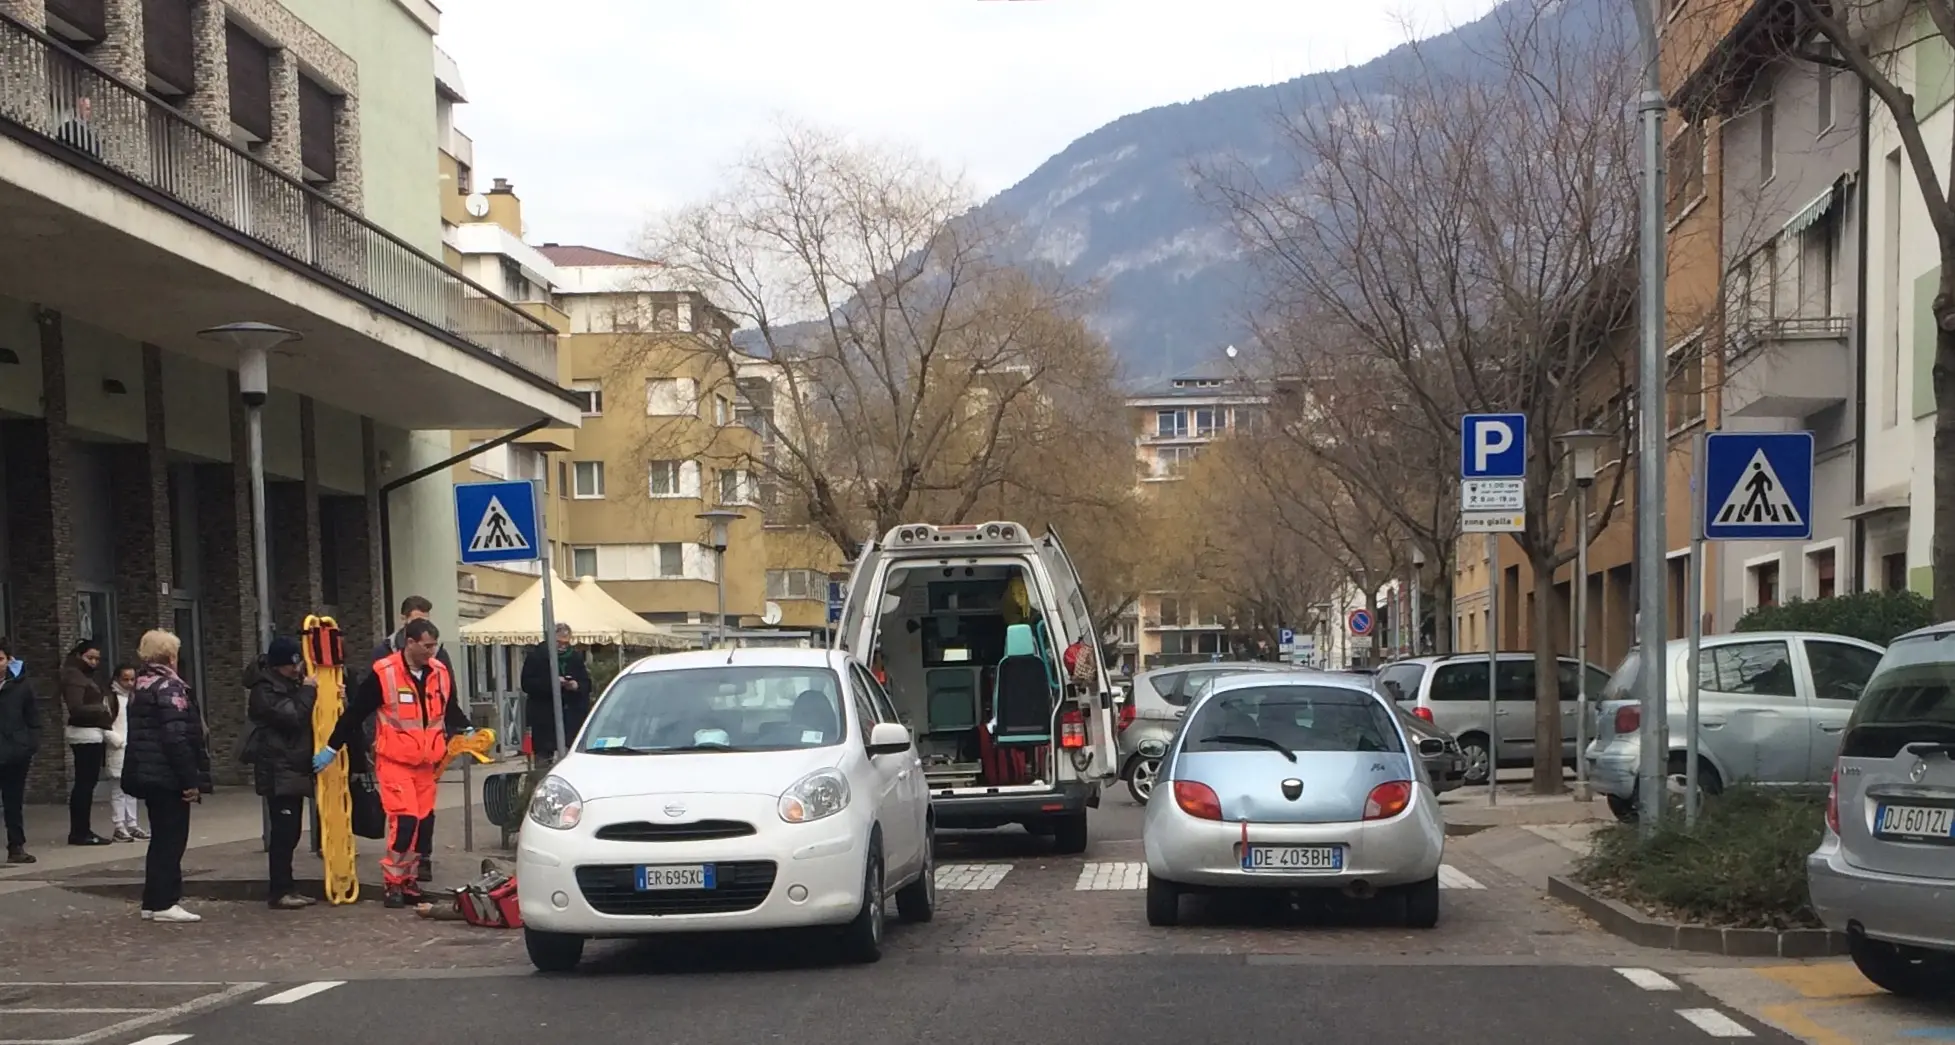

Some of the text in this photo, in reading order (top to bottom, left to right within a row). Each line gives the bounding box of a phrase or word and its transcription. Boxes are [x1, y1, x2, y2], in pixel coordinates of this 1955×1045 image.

[1475, 421, 1513, 471] P
[1282, 630, 1293, 643] P
[1254, 849, 1273, 866] DE
[1280, 849, 1331, 866] 403BH
[647, 870, 662, 886] ER
[666, 869, 704, 885] 695XC
